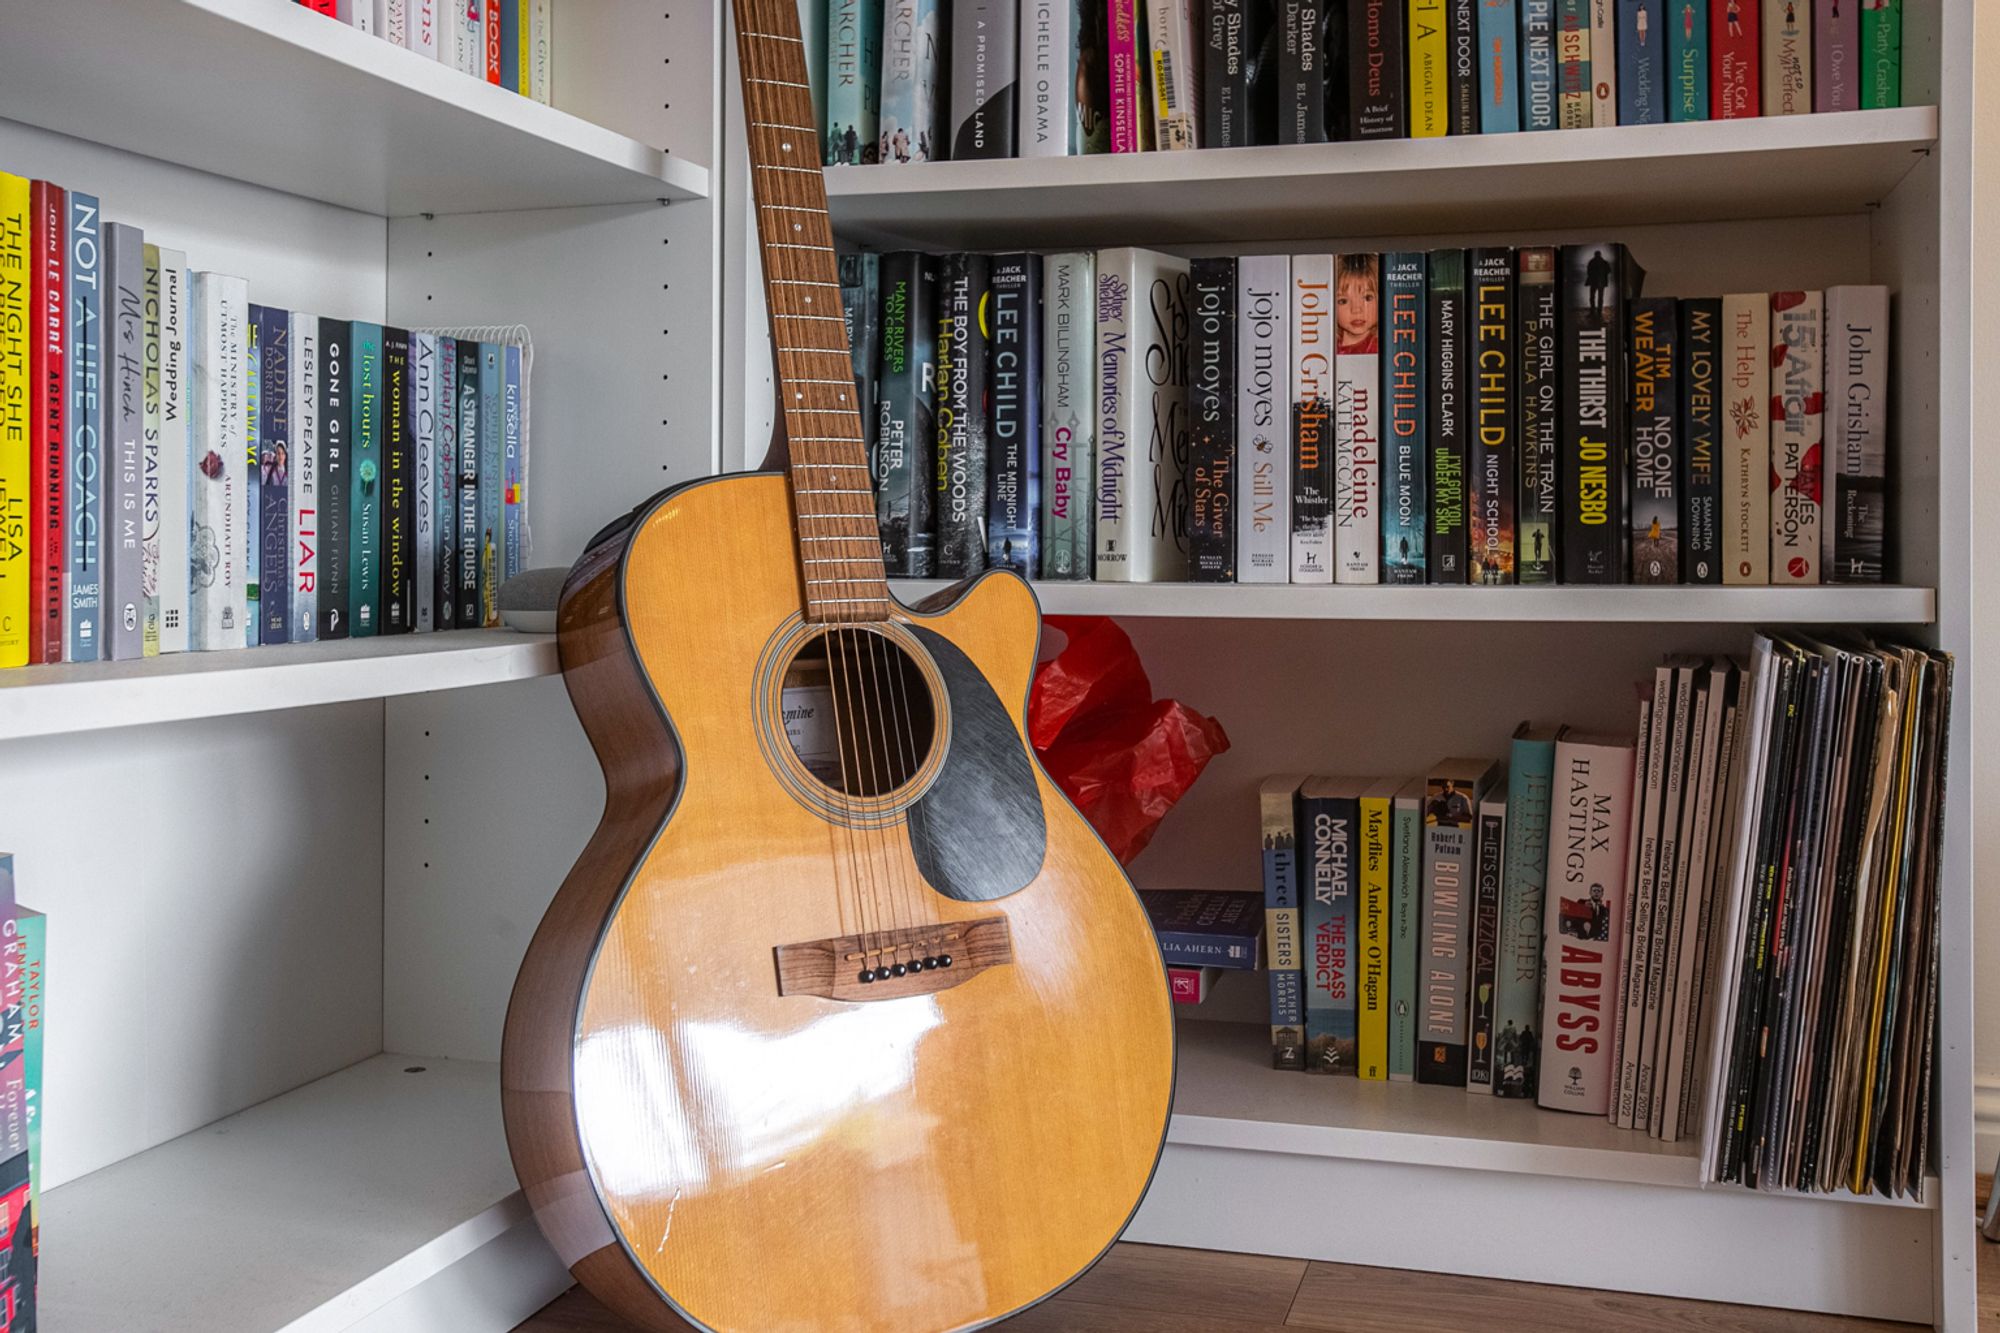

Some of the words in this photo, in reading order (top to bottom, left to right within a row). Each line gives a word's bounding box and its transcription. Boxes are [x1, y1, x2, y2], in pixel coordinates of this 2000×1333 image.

[488, 10, 499, 74] BOOK
[977, 21, 985, 29] A
[1227, 13, 1241, 75] Shades
[1287, 2, 1299, 55] Darker
[1301, 9, 1316, 71] Shades
[1777, 38, 1797, 59] My
[976, 35, 985, 106] PROMISED
[1114, 53, 1125, 93] SOPHIE
[1423, 52, 1433, 97] ABIGAIL
[1529, 36, 1549, 76] NEXT
[1563, 15, 1581, 99] AUSCHWITZ
[1679, 48, 1699, 113] Surprise
[1735, 61, 1748, 84] I've
[1036, 80, 1049, 144] OBAMA
[1222, 87, 1231, 103] EL
[1531, 81, 1550, 126] DOOR
[1735, 87, 1748, 109] Got
[1781, 65, 1797, 114] Perfect
[976, 112, 985, 148] LAND
[1115, 98, 1126, 153] KINSELLA
[1222, 107, 1233, 147] James
[1424, 101, 1433, 131] DEAN
[6, 213, 22, 271] THE
[1484, 258, 1505, 266] JACK
[165, 268, 180, 336] Journal
[953, 276, 968, 311] THE
[1056, 264, 1071, 310] MARK
[1197, 283, 1225, 334] jojo
[1297, 279, 1329, 345] John
[6, 281, 22, 375] NIGHT
[953, 316, 968, 354] BOY
[996, 293, 1018, 344] LEE
[1246, 288, 1280, 339] jojo
[1392, 294, 1416, 344] LEE
[1441, 300, 1454, 336] MARY
[1479, 285, 1505, 342] LEE
[144, 268, 160, 415] NICHOLAS
[937, 319, 953, 401] Harlan
[1056, 313, 1070, 408] BILLINGHAM
[1441, 339, 1454, 391] HIGGINS
[1524, 320, 1537, 384] PAULA
[1579, 327, 1606, 362] THE
[1635, 311, 1654, 412] WEAVER
[1655, 343, 1671, 378] TIM
[165, 342, 180, 421] Wedding
[303, 337, 314, 409] LESLEY
[329, 343, 340, 407] GONE
[361, 354, 376, 387] lost
[418, 338, 433, 402] Ann
[463, 384, 476, 395] A
[953, 357, 967, 409] FROM
[996, 351, 1018, 438] CHILD
[1197, 340, 1222, 421] moyes
[1246, 344, 1274, 427] moyes
[1392, 351, 1416, 437] CHILD
[6, 385, 22, 442] SHE
[48, 371, 60, 429] AGENT
[361, 393, 375, 448] hours
[392, 370, 403, 442] woman
[505, 384, 518, 459] kinsella
[1299, 353, 1329, 470] Grisham
[1337, 379, 1353, 431] KATE
[1441, 393, 1454, 437] CLARK
[1479, 350, 1505, 446] CHILD
[1579, 365, 1607, 428] THIRST
[303, 416, 313, 494] PEARSE
[329, 420, 340, 473] GIRL
[463, 398, 476, 480] STRANGER
[879, 400, 891, 491] ROBINSON
[890, 420, 904, 469] PETER
[937, 407, 953, 491] Coben
[953, 412, 967, 447] THE
[1007, 443, 1017, 467] THE
[1052, 427, 1072, 460] Cry
[1351, 388, 1377, 519] madeleine
[1524, 396, 1538, 488] HAWKINS
[1653, 416, 1671, 448] NO
[144, 428, 159, 522] SPARKS
[392, 451, 403, 469] in
[418, 409, 434, 534] Cleeves
[1337, 437, 1353, 528] McCANN
[1399, 446, 1411, 481] BLUE
[1435, 447, 1448, 486] UNDER
[1486, 454, 1499, 496] NIGHT
[1636, 426, 1653, 488] HOME
[1653, 453, 1671, 498] ONE
[48, 441, 60, 530] RUNNING
[392, 476, 404, 509] the
[464, 484, 476, 500] IN
[952, 452, 966, 522] WOODS
[997, 474, 1008, 501] LINE
[1005, 471, 1017, 531] MIDNIGHT
[1051, 467, 1072, 519] Baby
[1399, 484, 1411, 526] MOON
[1435, 488, 1448, 506] MY
[8, 498, 23, 561] LISA
[330, 485, 339, 541] GILLIAN
[361, 503, 372, 545] Susan
[443, 505, 453, 540] Run
[464, 503, 476, 533] THE
[1435, 508, 1448, 535] SKIN
[1486, 499, 1499, 555] SCHOOL
[1691, 497, 1701, 551] DOWNING
[1702, 496, 1712, 551] SAMANTHA
[299, 509, 316, 593] LIAR
[330, 549, 339, 594] FLYNN
[361, 549, 372, 590] Lewis
[391, 518, 403, 597] window
[441, 545, 453, 595] Away
[464, 538, 476, 591] HOUSE
[48, 565, 60, 620] FIELD
[72, 583, 99, 596] JAMES
[72, 596, 98, 609] SMITH
[1364, 809, 1382, 872] Mayflies
[1400, 816, 1413, 853] Svetlana
[1522, 772, 1547, 872] JEFFREY
[1564, 758, 1591, 883] HASTINGS
[1590, 793, 1612, 853] MAX
[1314, 813, 1331, 905] CONNELLY
[1331, 819, 1348, 901] MICHAEL
[1399, 855, 1412, 899] Alexievich
[1643, 837, 1655, 876] Ireland's
[1661, 839, 1674, 879] Ireland's
[1366, 882, 1381, 942] Andrew
[1431, 862, 1460, 959] BOWLING
[1641, 878, 1652, 901] Best
[1659, 881, 1670, 903] Best
[1332, 915, 1346, 944] THE
[1515, 884, 1540, 983] ARCHER
[1637, 902, 1650, 932] Selling
[1654, 904, 1667, 935] Selling
[1184, 945, 1222, 954] AHERN
[1315, 922, 1330, 992] VERDICT
[1332, 947, 1346, 999] BRASS
[1636, 935, 1647, 961] Bridal
[1653, 938, 1664, 963] Bridal
[3, 919, 23, 1044] GRAHAM
[28, 960, 41, 1030] TAYLOR
[1364, 946, 1382, 1011] O'Hagan
[1428, 970, 1455, 1033] ALONE
[1556, 945, 1603, 1054] ABYSS
[1631, 963, 1644, 1008] Magazine
[1647, 966, 1661, 1010] Magazine
[1624, 1061, 1635, 1091] Annual
[1639, 1064, 1651, 1093] Annual
[1621, 1093, 1632, 1117] 2022
[1637, 1096, 1648, 1120] 2023
